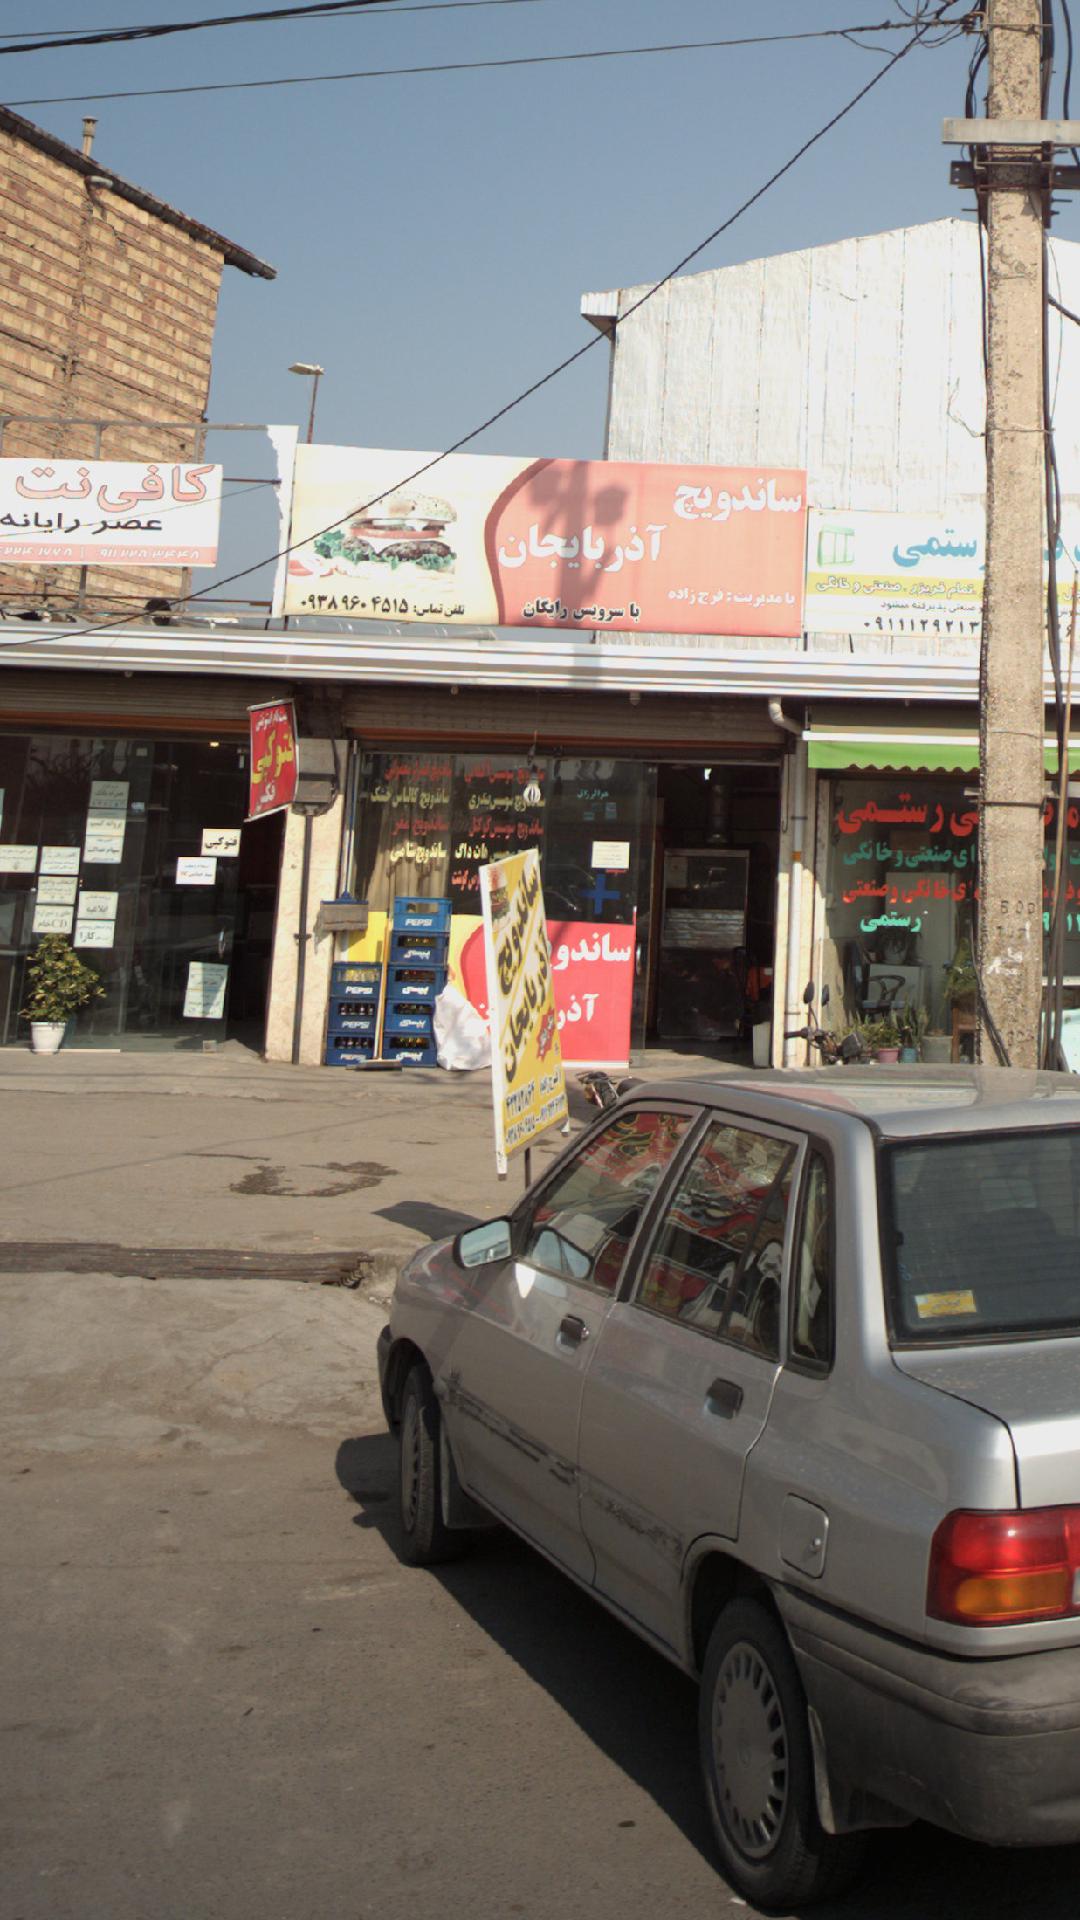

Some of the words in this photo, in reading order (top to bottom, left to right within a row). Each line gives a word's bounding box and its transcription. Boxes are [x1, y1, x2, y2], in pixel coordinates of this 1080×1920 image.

[16, 466, 92, 500] نت
[97, 464, 215, 514] کافی
[672, 478, 803, 520] ساندویچ
[0, 511, 81, 535] رایانه
[92, 516, 163, 535] عصر
[497, 522, 668, 573] آذربایجان
[892, 528, 985, 572] ستمی
[815, 574, 851, 592] خانگی
[863, 579, 901, 594] صنعتی
[443, 603, 466, 617] تلفن
[522, 599, 568, 620] رایگان
[572, 606, 624, 622] سرویس
[629, 603, 641, 624] با
[863, 616, 981, 635] ۰۹۱۱۱۲۹۲۱۳
[837, 791, 944, 834] رستمی
[843, 840, 893, 865] خانگی
[904, 846, 952, 868] صنعتی
[842, 879, 889, 904] صنعتی
[405, 918, 433, 927] PEPSI
[860, 911, 922, 933] رستمی
[551, 931, 632, 971] ساندو
[345, 985, 374, 995] PEPSI
[341, 1020, 371, 1030] PEPSI
